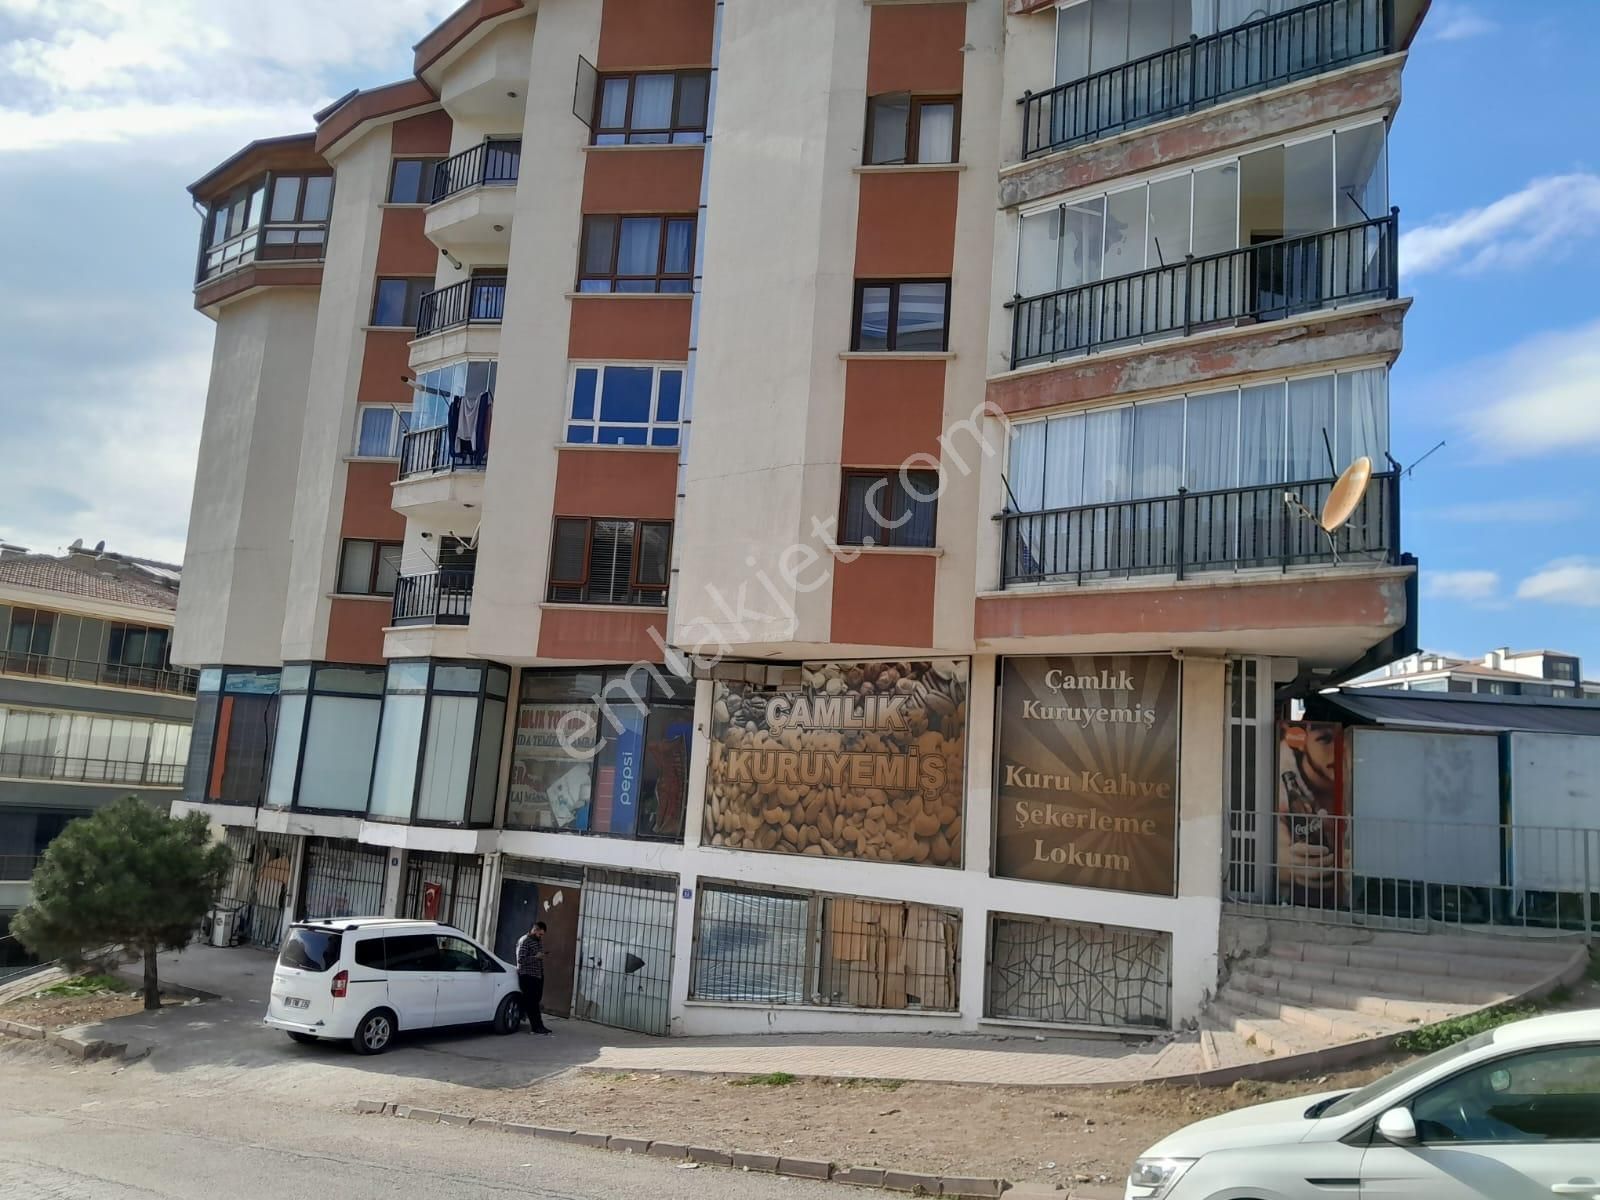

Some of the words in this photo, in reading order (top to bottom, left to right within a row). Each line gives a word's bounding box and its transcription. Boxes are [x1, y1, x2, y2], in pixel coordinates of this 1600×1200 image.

[1045, 669, 1135, 694] Çamlık
[765, 694, 911, 737] ÇAMLIK
[1022, 700, 1156, 728] Kuruyemiş
[620, 751, 633, 806] pepsi
[726, 745, 948, 800] KURUYEMİŞ
[1006, 765, 1071, 791] Kuru
[1081, 771, 1170, 799] Kahve
[1015, 801, 1156, 836] Şekerleme
[1033, 839, 1131, 872] Lokum
